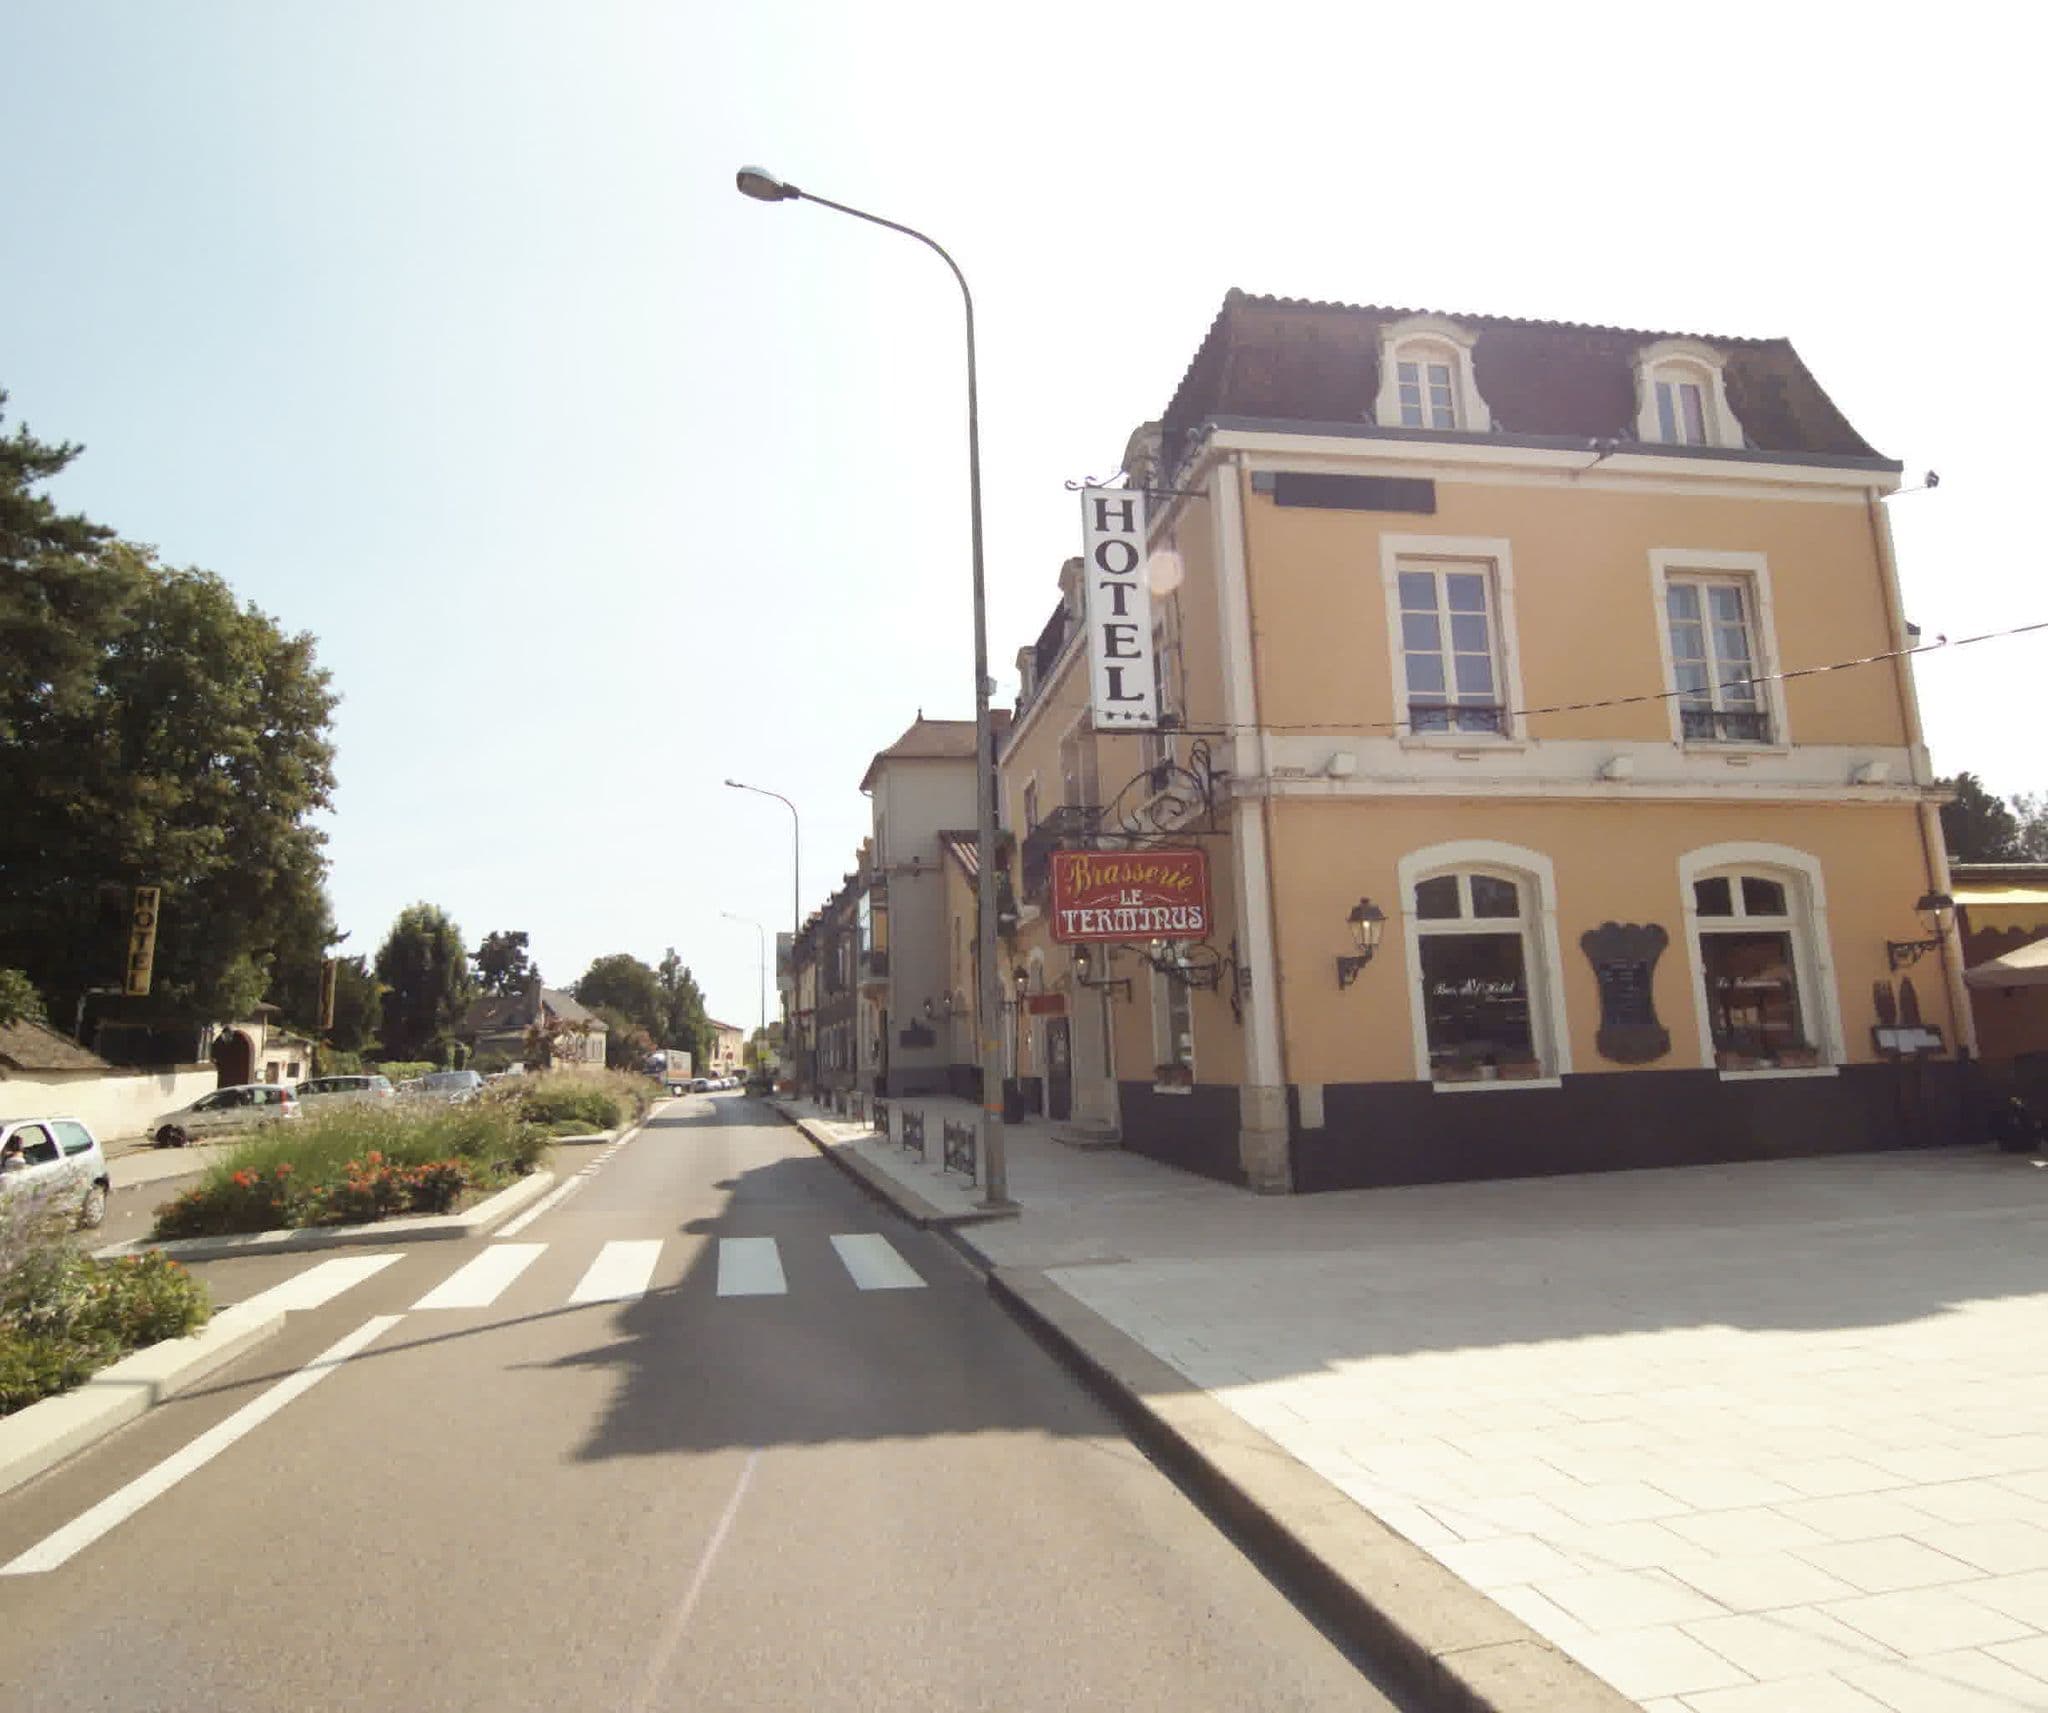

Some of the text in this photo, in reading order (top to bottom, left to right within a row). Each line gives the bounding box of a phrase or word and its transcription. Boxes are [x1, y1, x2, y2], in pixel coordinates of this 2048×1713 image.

[1093, 498, 1145, 701] HOTEL
[1065, 855, 1193, 897] Brasserie
[1120, 889, 1143, 905] LE
[1062, 906, 1203, 933] TERMINUS
